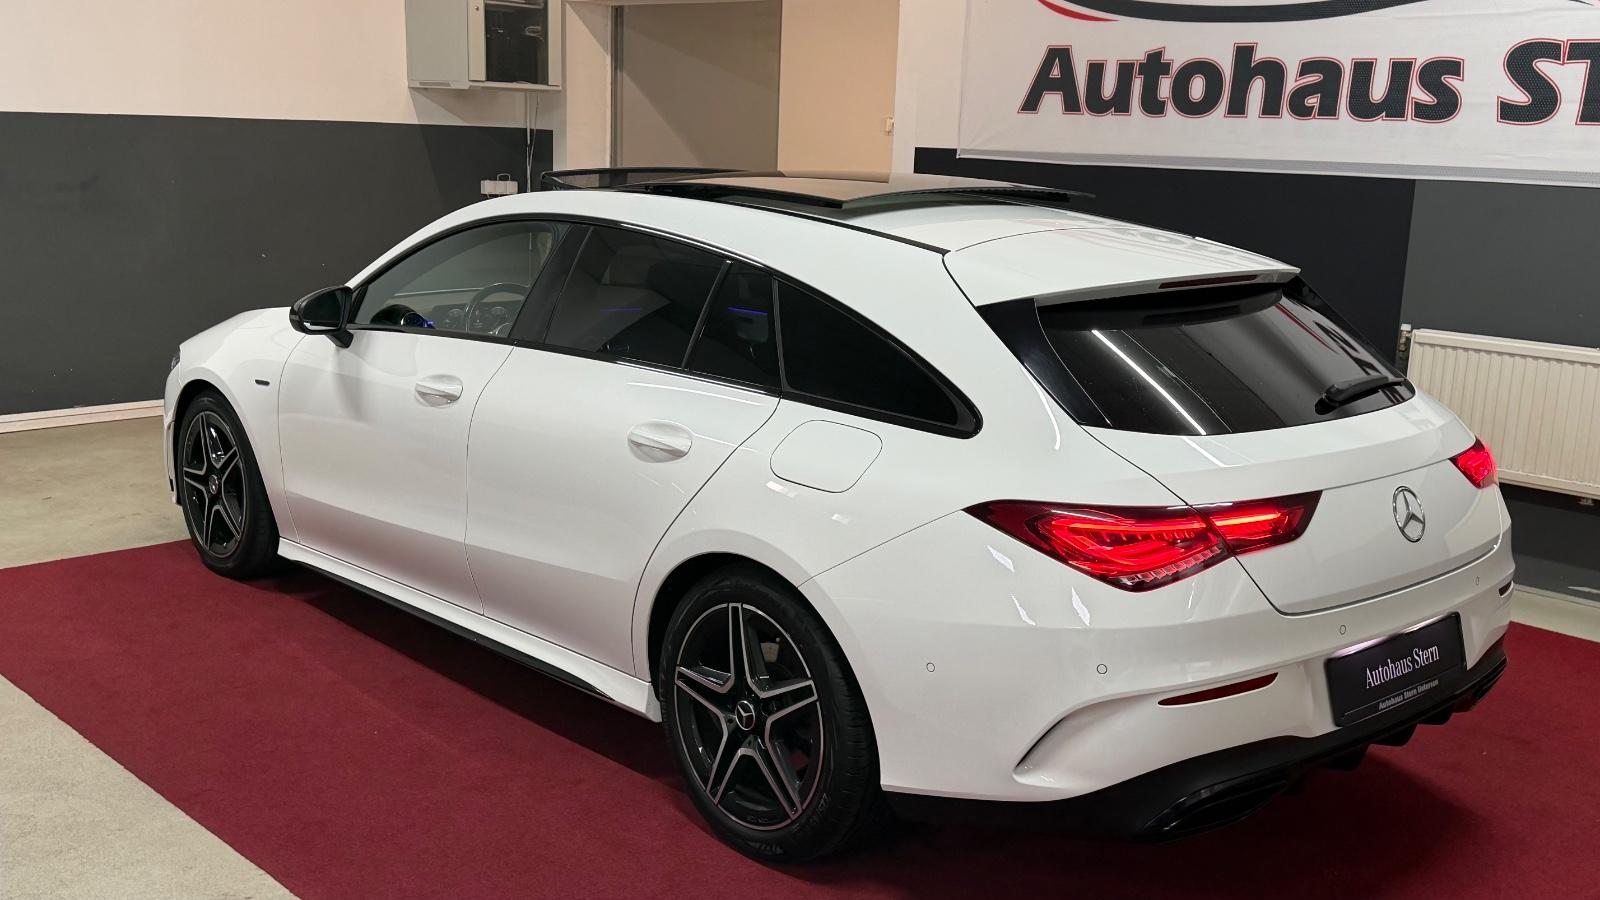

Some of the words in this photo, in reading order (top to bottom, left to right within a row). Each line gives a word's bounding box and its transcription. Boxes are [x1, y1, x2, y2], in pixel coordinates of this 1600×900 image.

[1017, 42, 1464, 124] Autohaus
[1367, 657, 1412, 688] Autohaus
[1413, 646, 1439, 668] Stern
